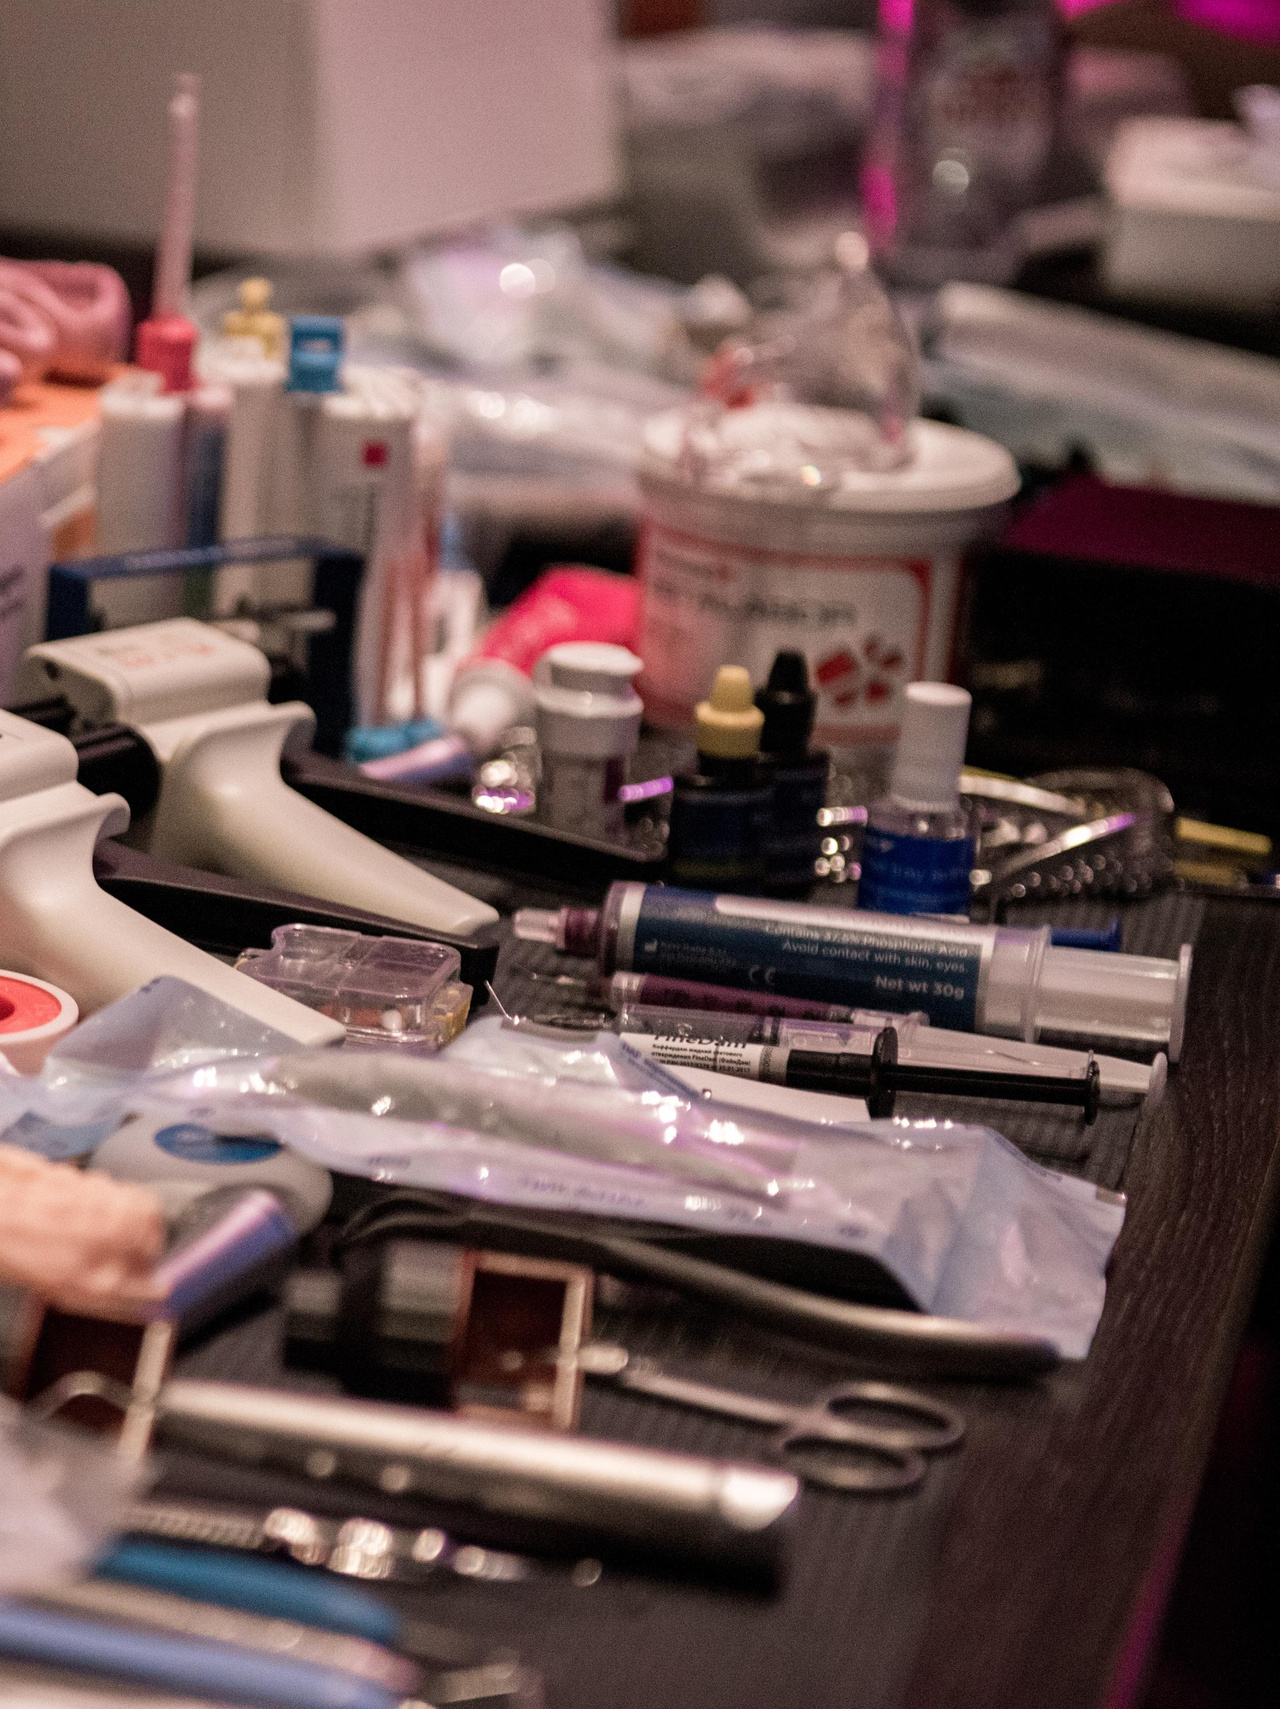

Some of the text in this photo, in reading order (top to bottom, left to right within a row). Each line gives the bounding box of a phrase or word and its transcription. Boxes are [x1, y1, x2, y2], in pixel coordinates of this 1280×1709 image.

[782, 941, 819, 955] Avoid
[822, 946, 870, 962] contact
[874, 950, 901, 966] with
[905, 956, 933, 970] skin,
[875, 974, 965, 1001] Net wt 30g
